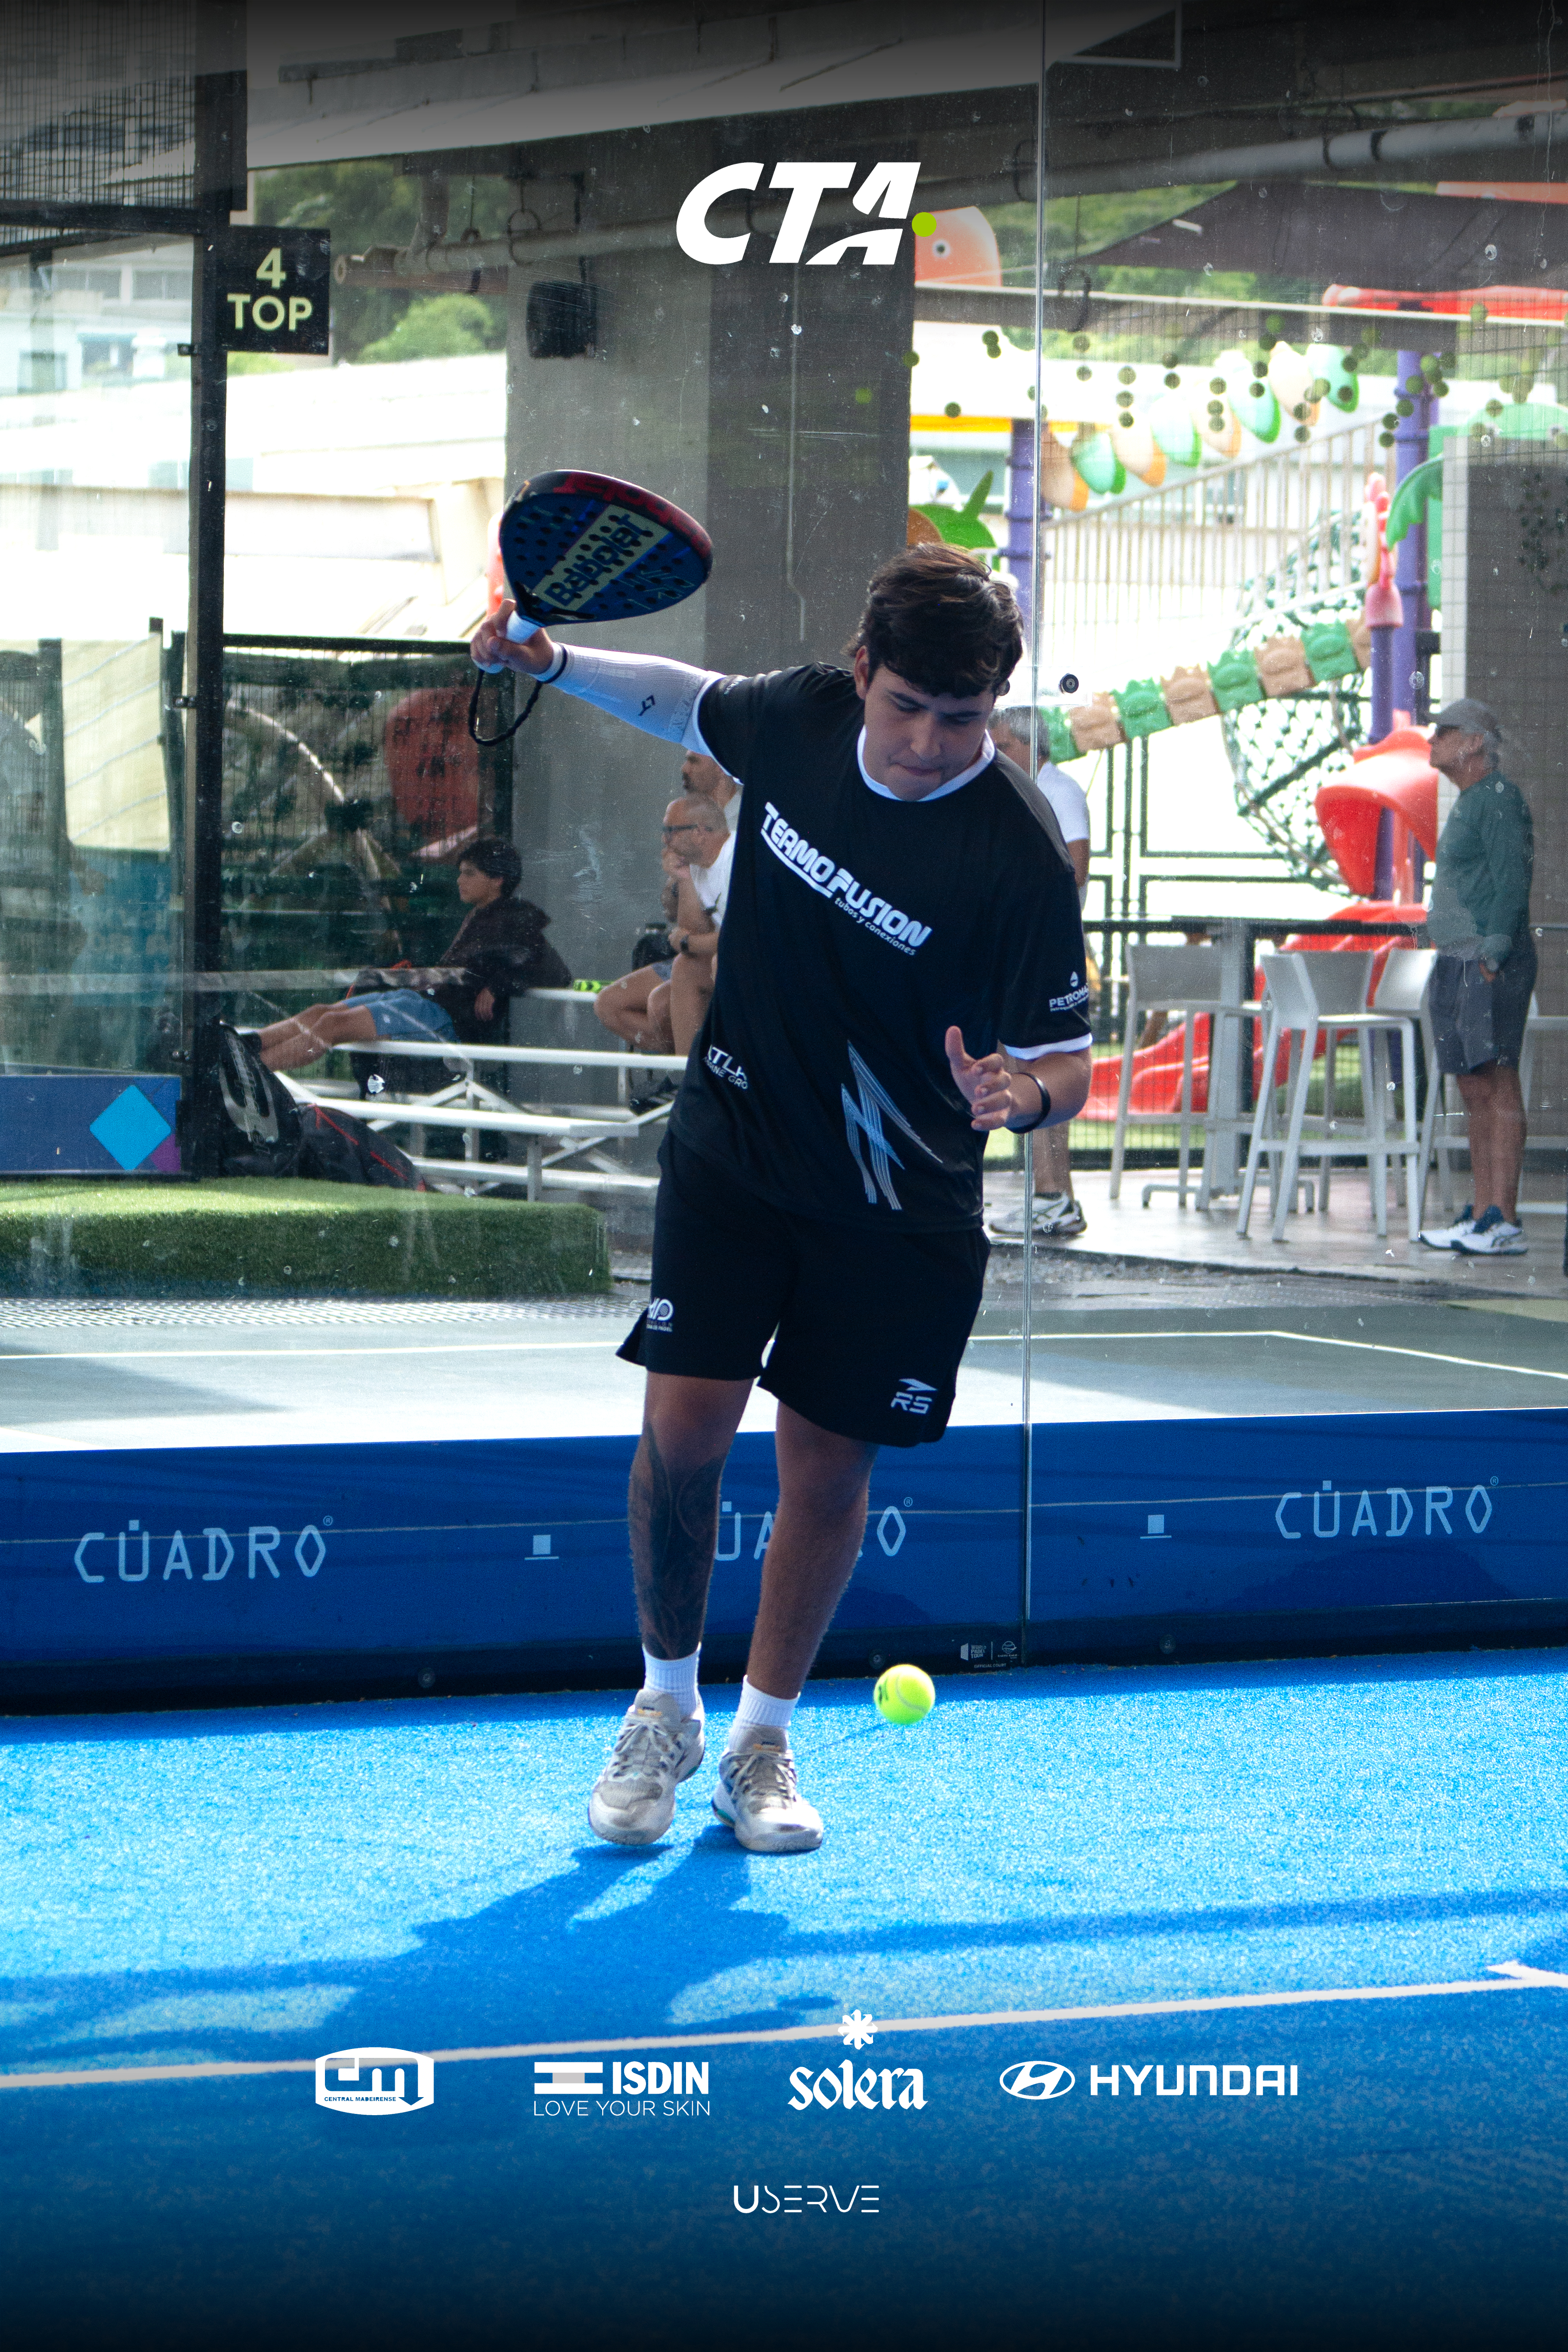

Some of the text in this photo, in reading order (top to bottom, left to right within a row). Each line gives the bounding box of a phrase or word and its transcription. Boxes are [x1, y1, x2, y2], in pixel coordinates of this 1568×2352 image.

[256, 247, 286, 289] 4
[227, 293, 312, 331] TOP
[834, 897, 858, 918] tubos
[865, 921, 916, 956] conexiones
[891, 1391, 932, 1414] RS
